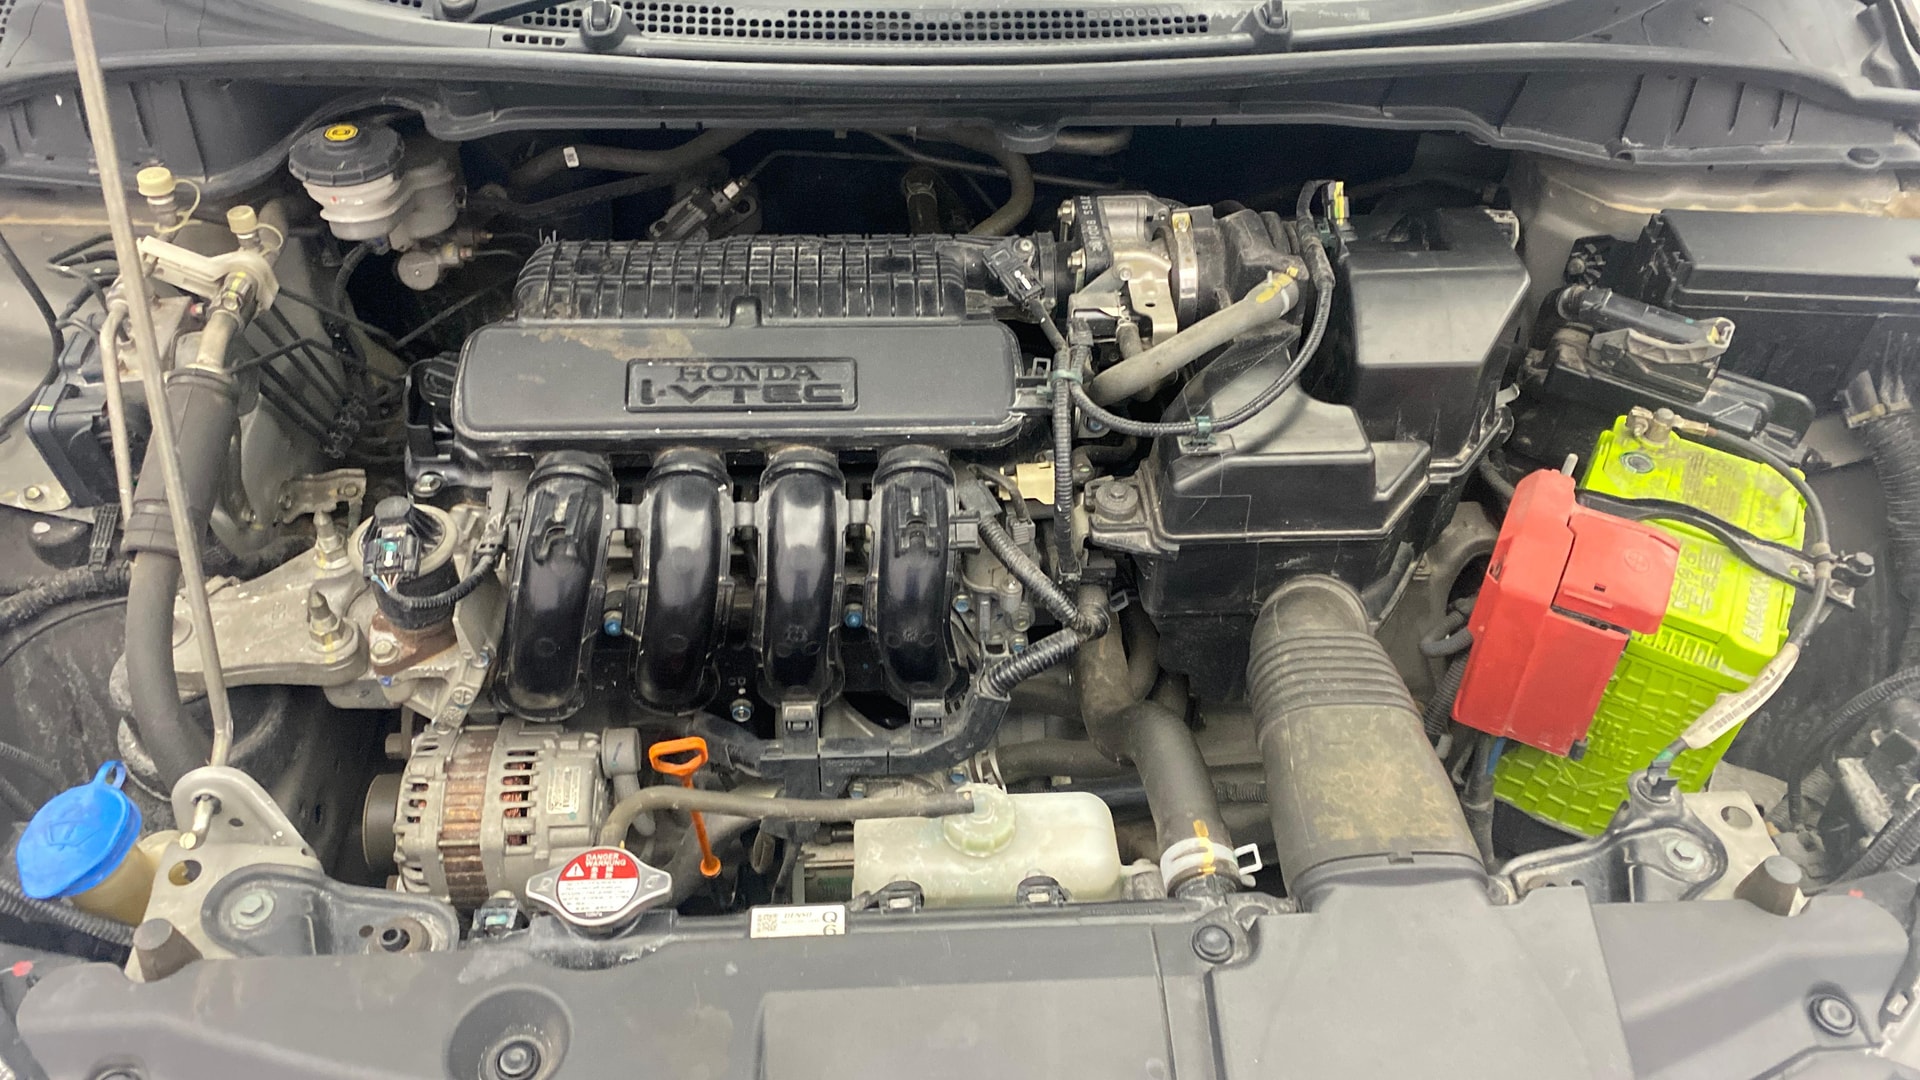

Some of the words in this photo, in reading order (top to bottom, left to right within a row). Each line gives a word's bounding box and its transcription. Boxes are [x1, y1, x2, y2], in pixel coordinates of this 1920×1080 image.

[675, 364, 821, 382] HONDA
[585, 853, 619, 861] DANGER
[822, 911, 838, 923] Q
